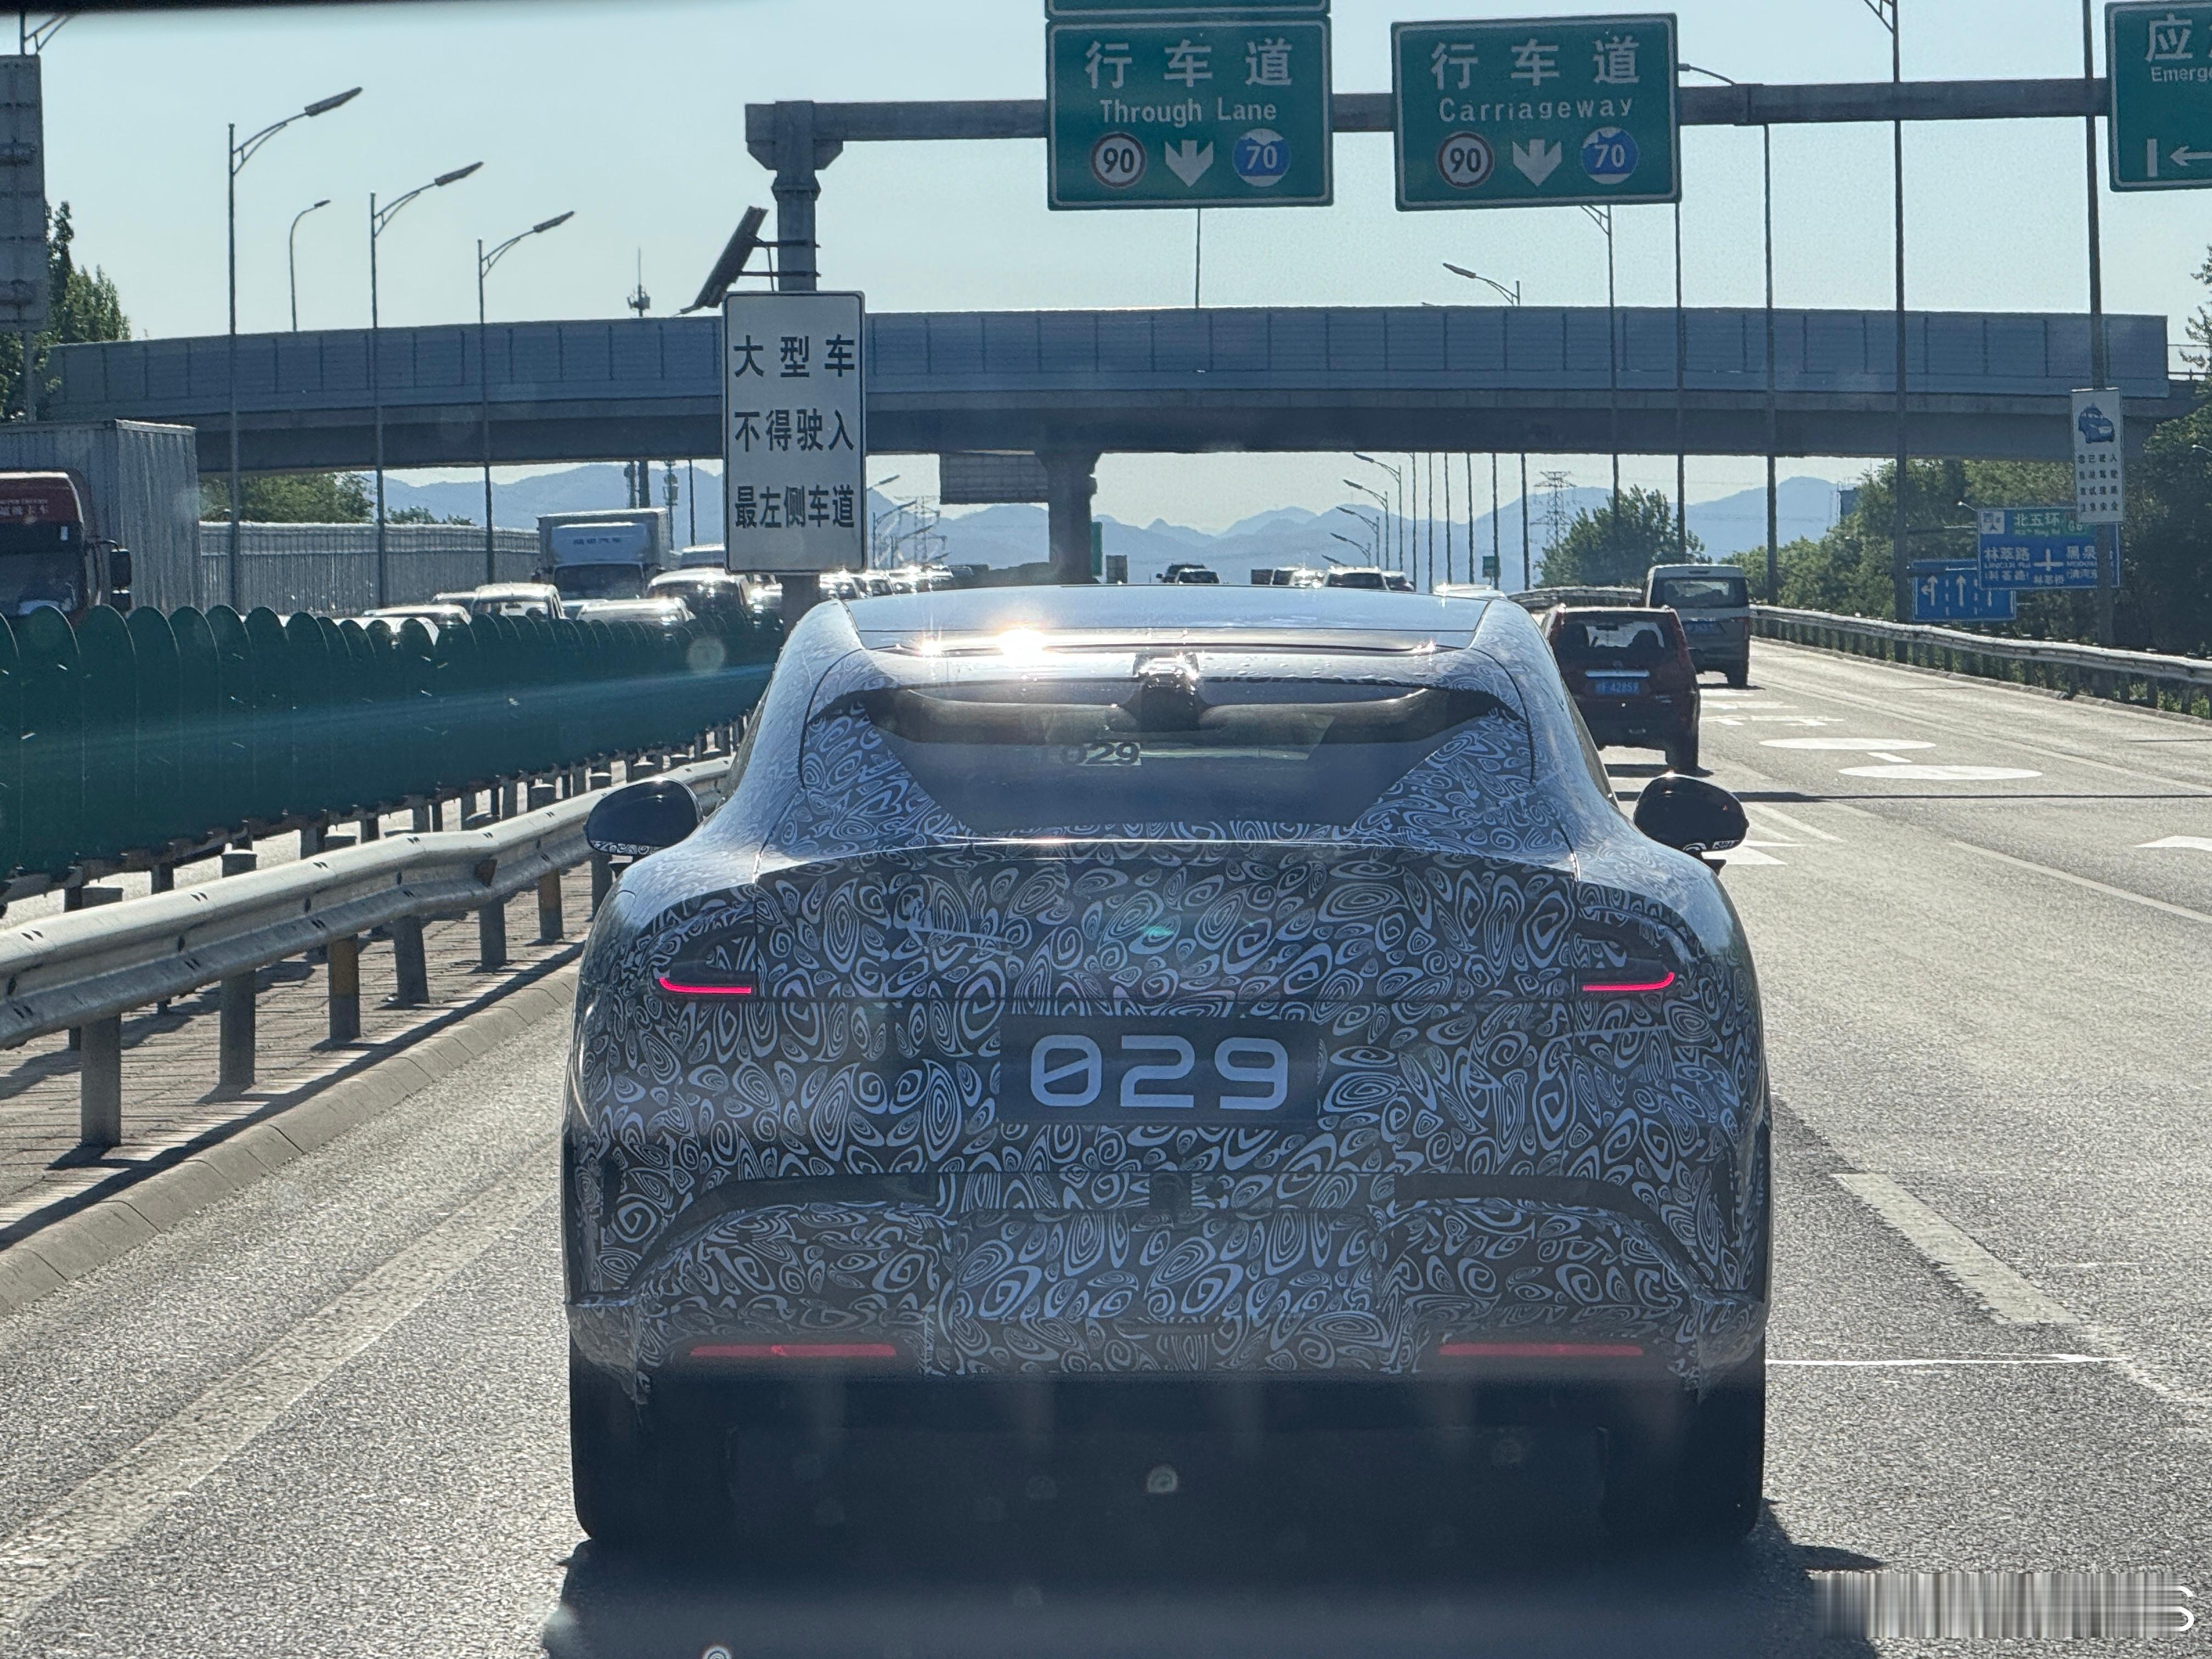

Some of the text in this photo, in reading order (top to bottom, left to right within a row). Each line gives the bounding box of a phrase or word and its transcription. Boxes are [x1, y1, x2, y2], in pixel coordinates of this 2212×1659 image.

[2145, 12, 2212, 63] 应
[1085, 37, 1293, 89] 行车道
[1430, 35, 1640, 90] 行车道
[1099, 97, 1278, 128] Through Lane
[1438, 97, 1633, 122] Carriageway
[1103, 147, 1135, 173] 90
[1246, 144, 1278, 170] 70
[1449, 147, 1481, 173] 90
[1594, 143, 1626, 169] 70
[733, 334, 856, 378] 大型车
[734, 407, 855, 453] 不得驶入
[734, 484, 855, 529] 最左侧车道
[2015, 512, 2061, 527] 北五环
[1060, 742, 1139, 765] 029
[1030, 1034, 1289, 1111] 029
